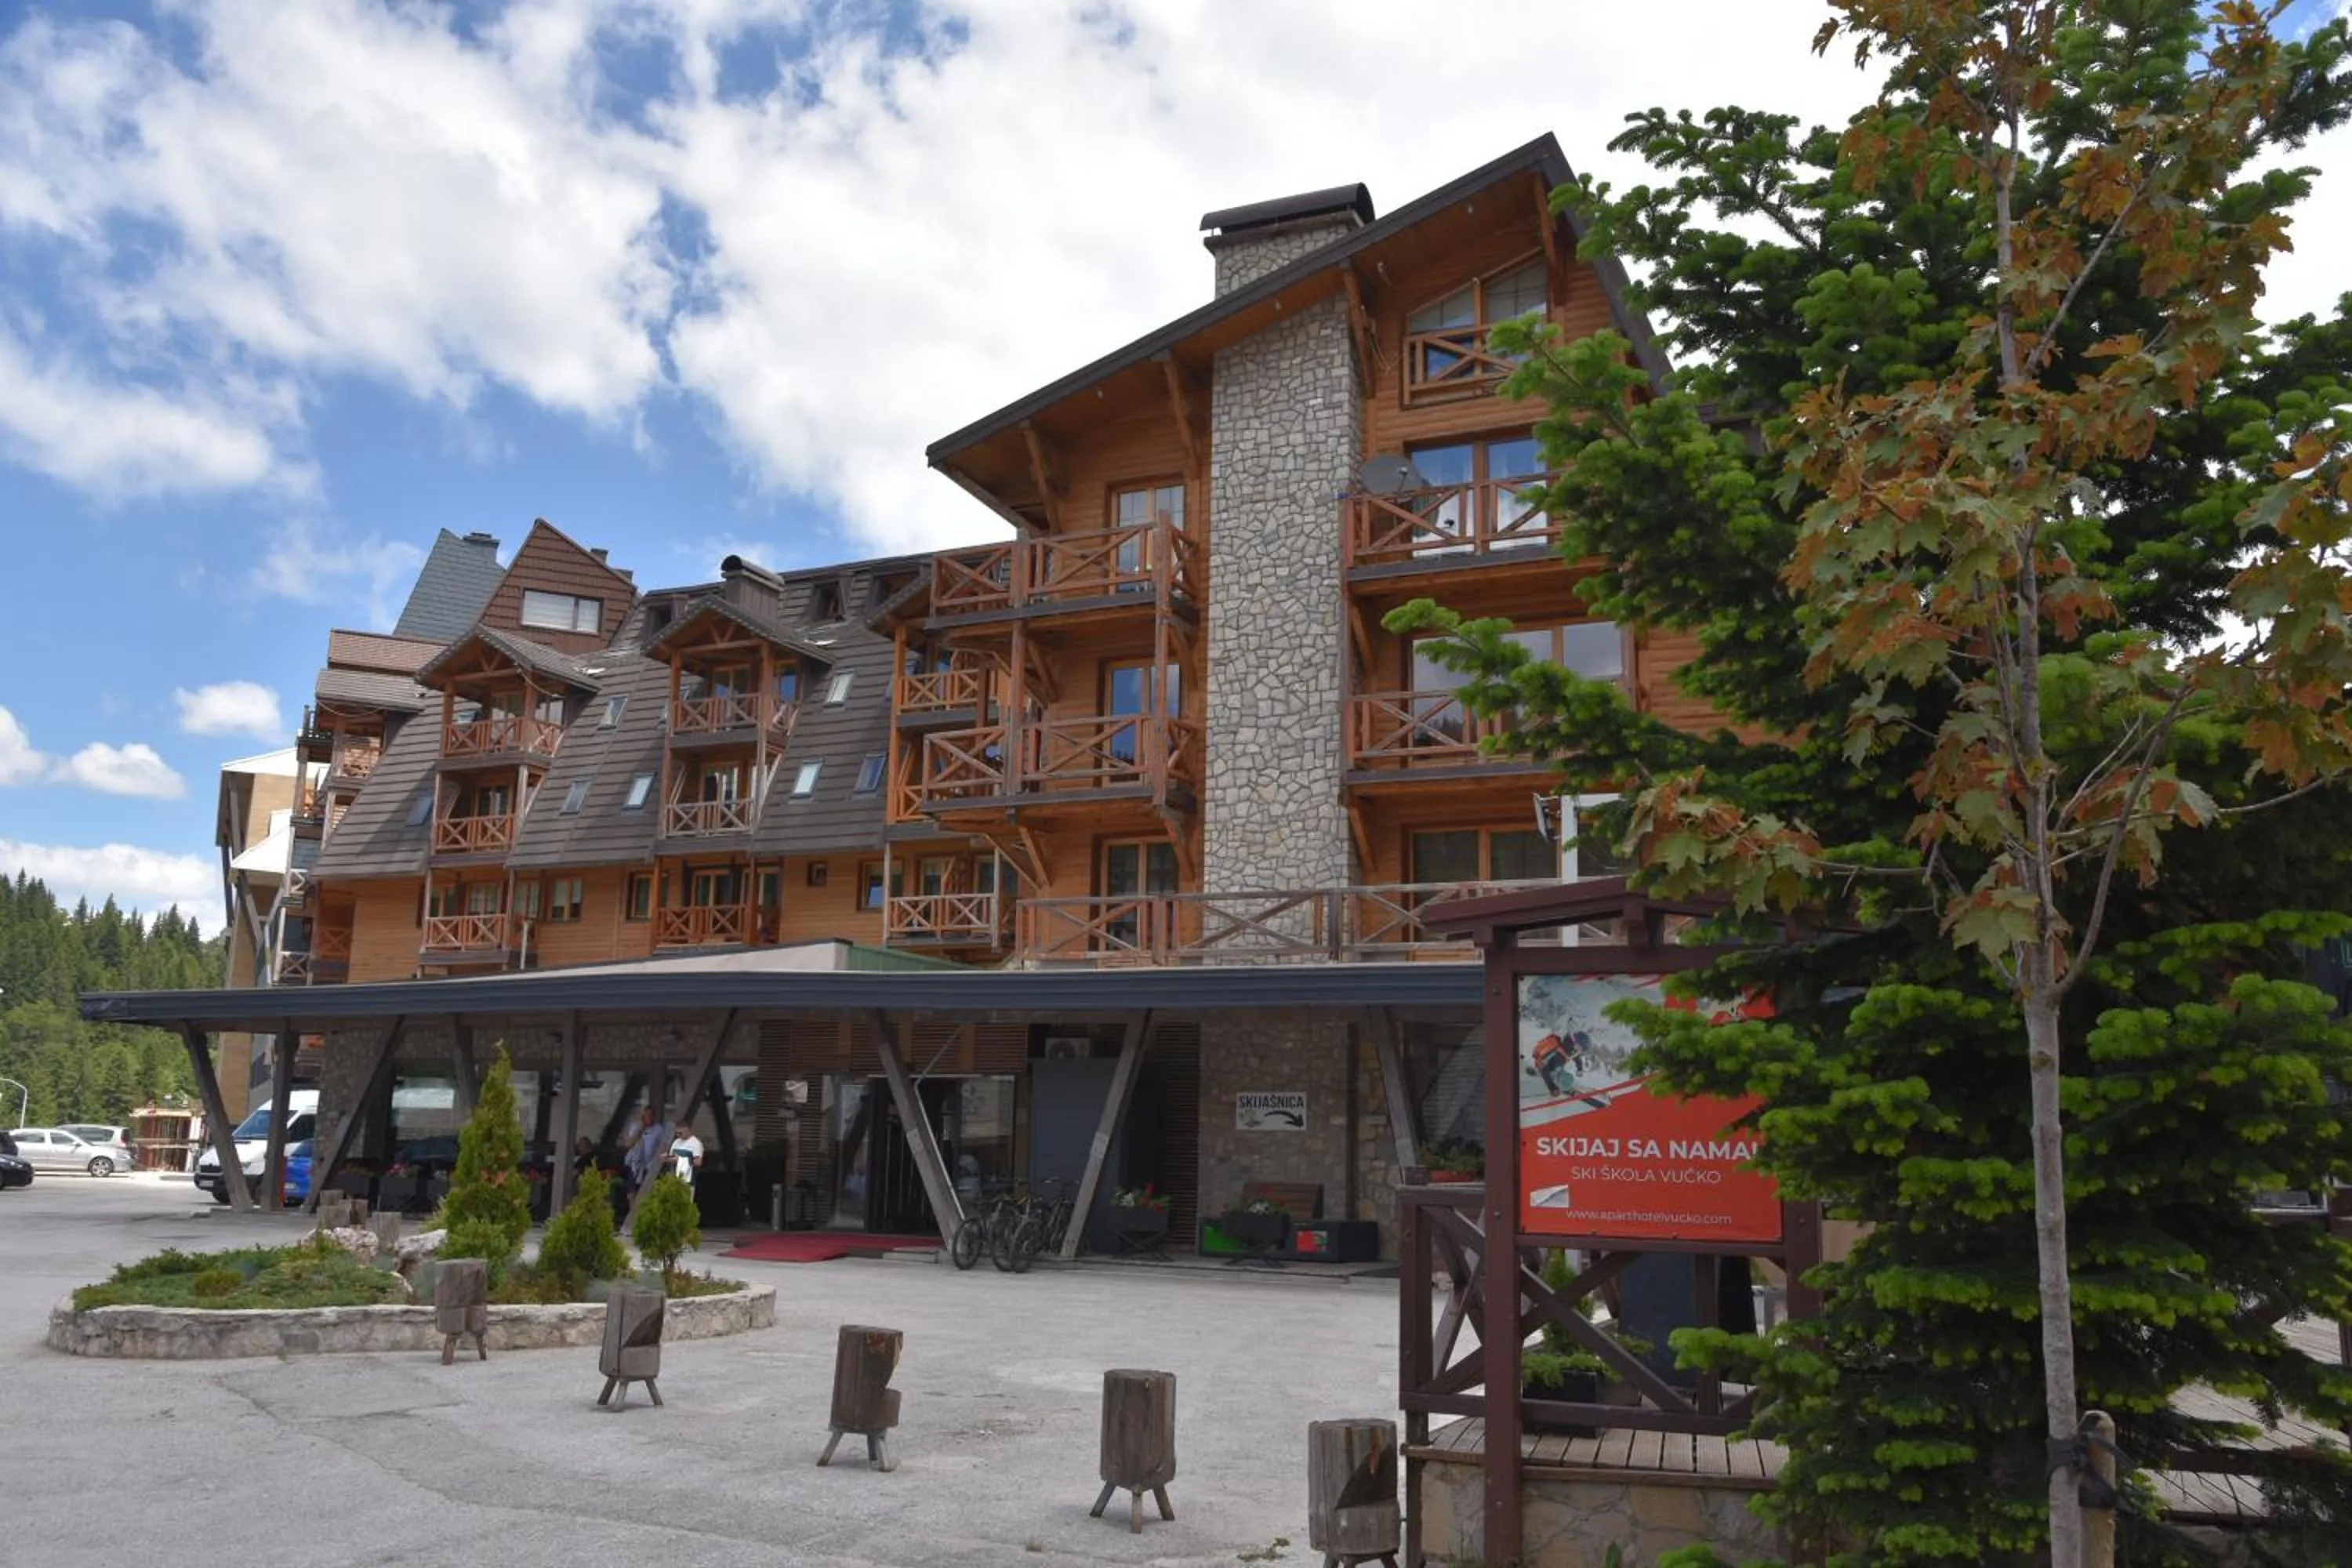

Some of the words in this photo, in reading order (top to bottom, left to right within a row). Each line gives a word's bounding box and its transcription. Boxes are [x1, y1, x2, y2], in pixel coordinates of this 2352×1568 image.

[1239, 1094, 1305, 1108] SKIJAŠNICA
[1536, 1137, 1620, 1158] SKIJAJ
[1627, 1139, 1662, 1159] SA
[1571, 1166, 1596, 1180] SKI
[1600, 1166, 1656, 1182] ŠKOLA
[1660, 1167, 1722, 1185] VUČKO
